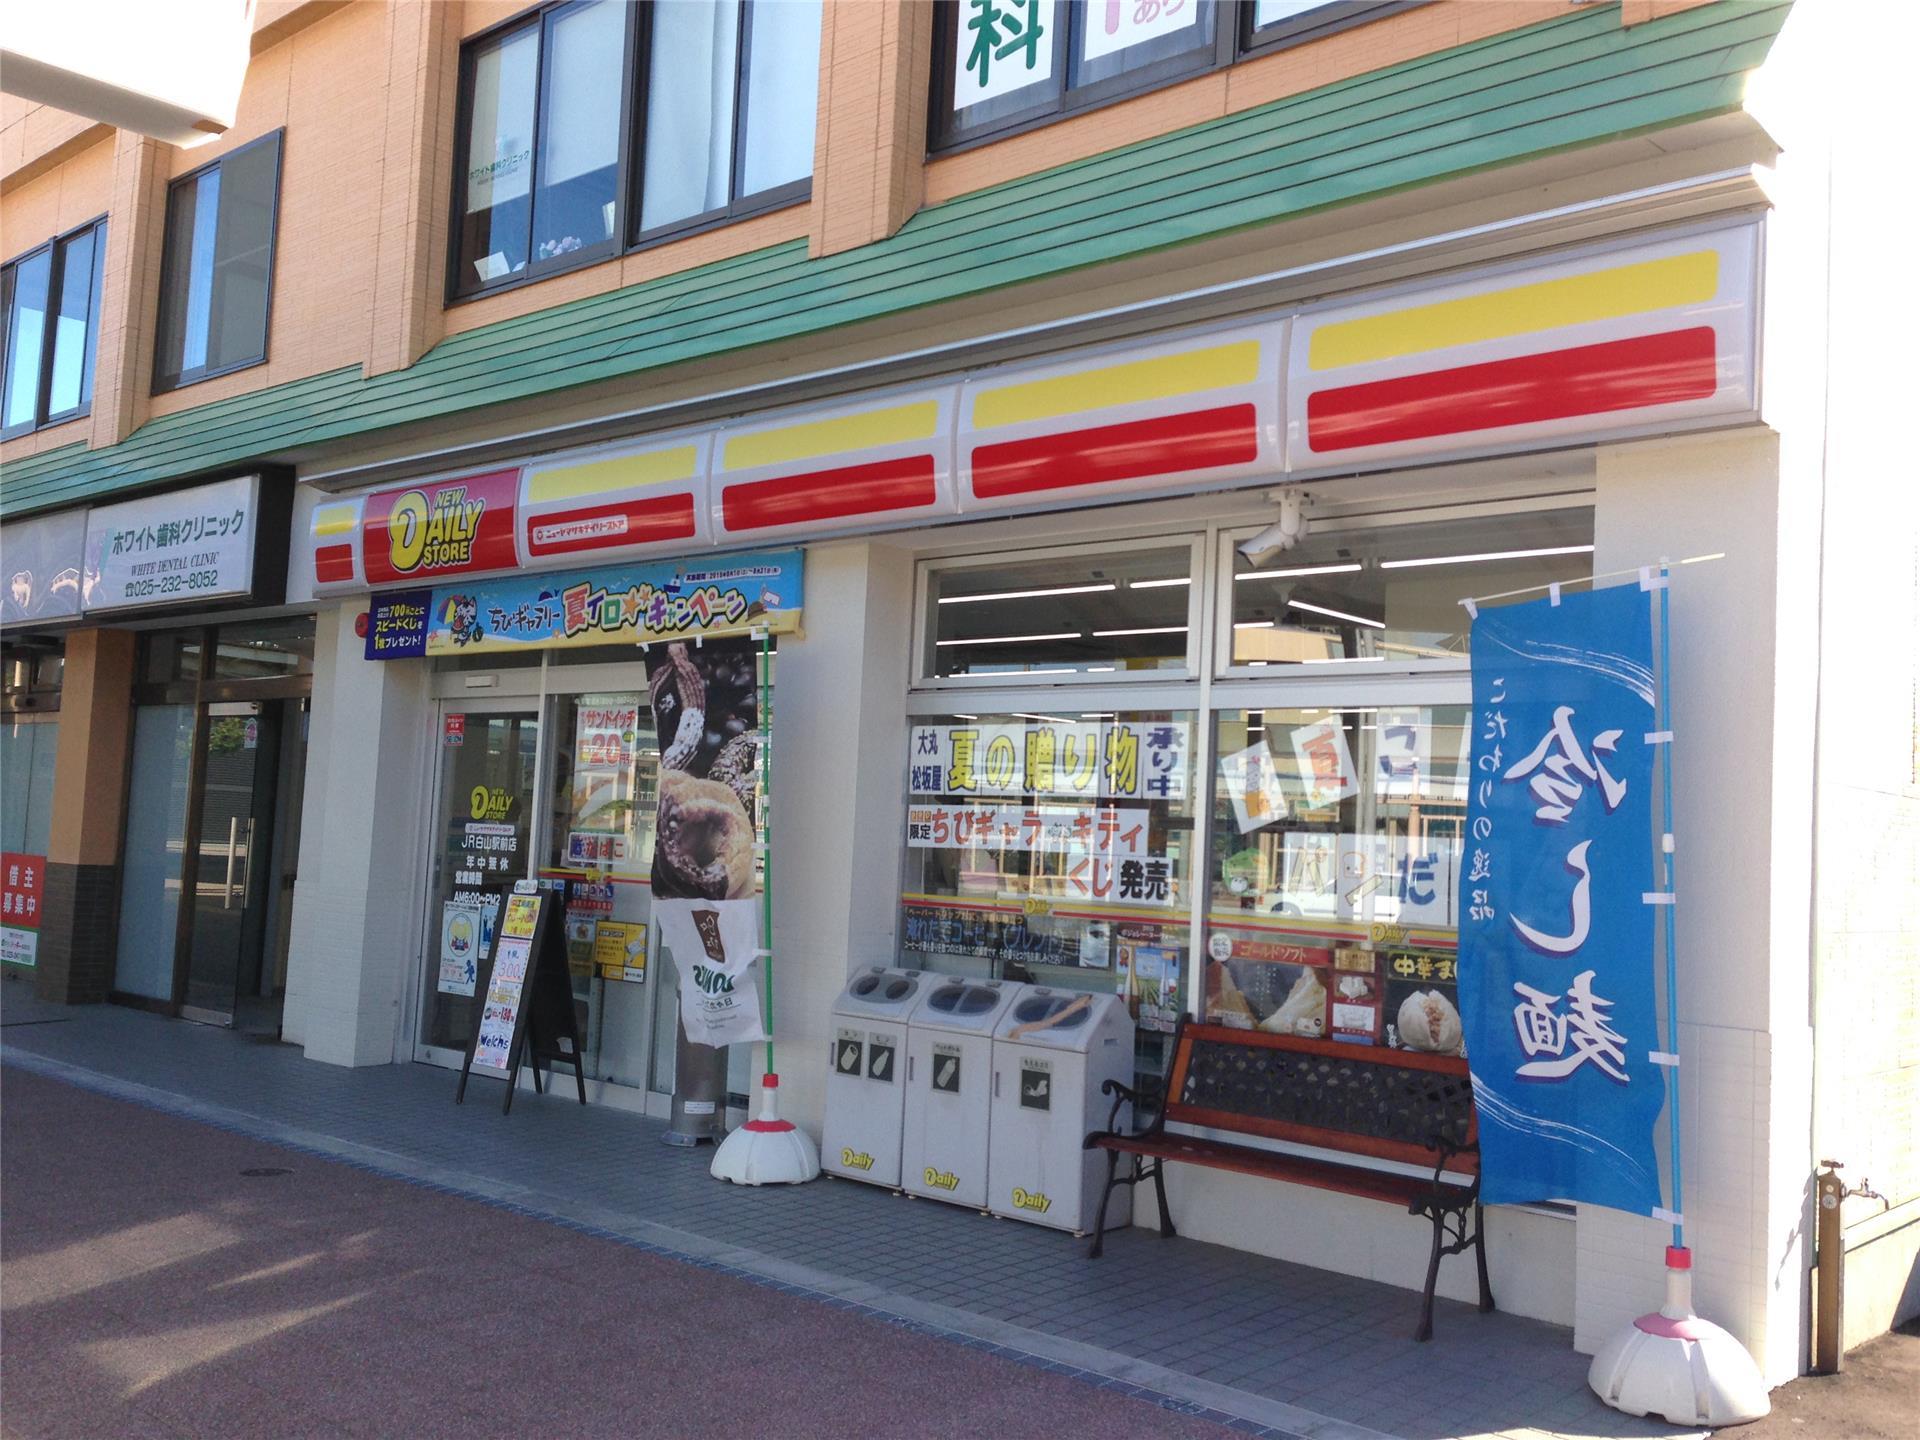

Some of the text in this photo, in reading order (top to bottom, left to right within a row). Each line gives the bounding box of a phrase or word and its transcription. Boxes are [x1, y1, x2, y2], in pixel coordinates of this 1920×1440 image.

[436, 488, 465, 508] NEW
[112, 509, 244, 556] ホワイト歯科クリニック
[388, 491, 484, 571] DAILY
[131, 552, 220, 576] WHITE DENTAL CLINIC
[423, 541, 470, 566] STORE
[134, 570, 218, 597] 025-232-8052
[488, 602, 560, 633] ちびギャラリー
[918, 729, 938, 755] 大丸
[948, 725, 1139, 795] 夏の贈り物
[1146, 726, 1184, 797] 承り中
[912, 764, 942, 792] 松坂屋
[461, 834, 517, 852] JR白山駅前店
[909, 823, 931, 840] 限定
[466, 855, 509, 872] 年中無休
[9, 864, 34, 889] 借主
[455, 870, 483, 886] 営業時間
[1068, 857, 1169, 899] くじ発売
[3, 892, 36, 917] 募集中
[842, 1147, 875, 1171] Daily
[924, 1167, 959, 1192] Daily
[1012, 1187, 1051, 1214] Daily
